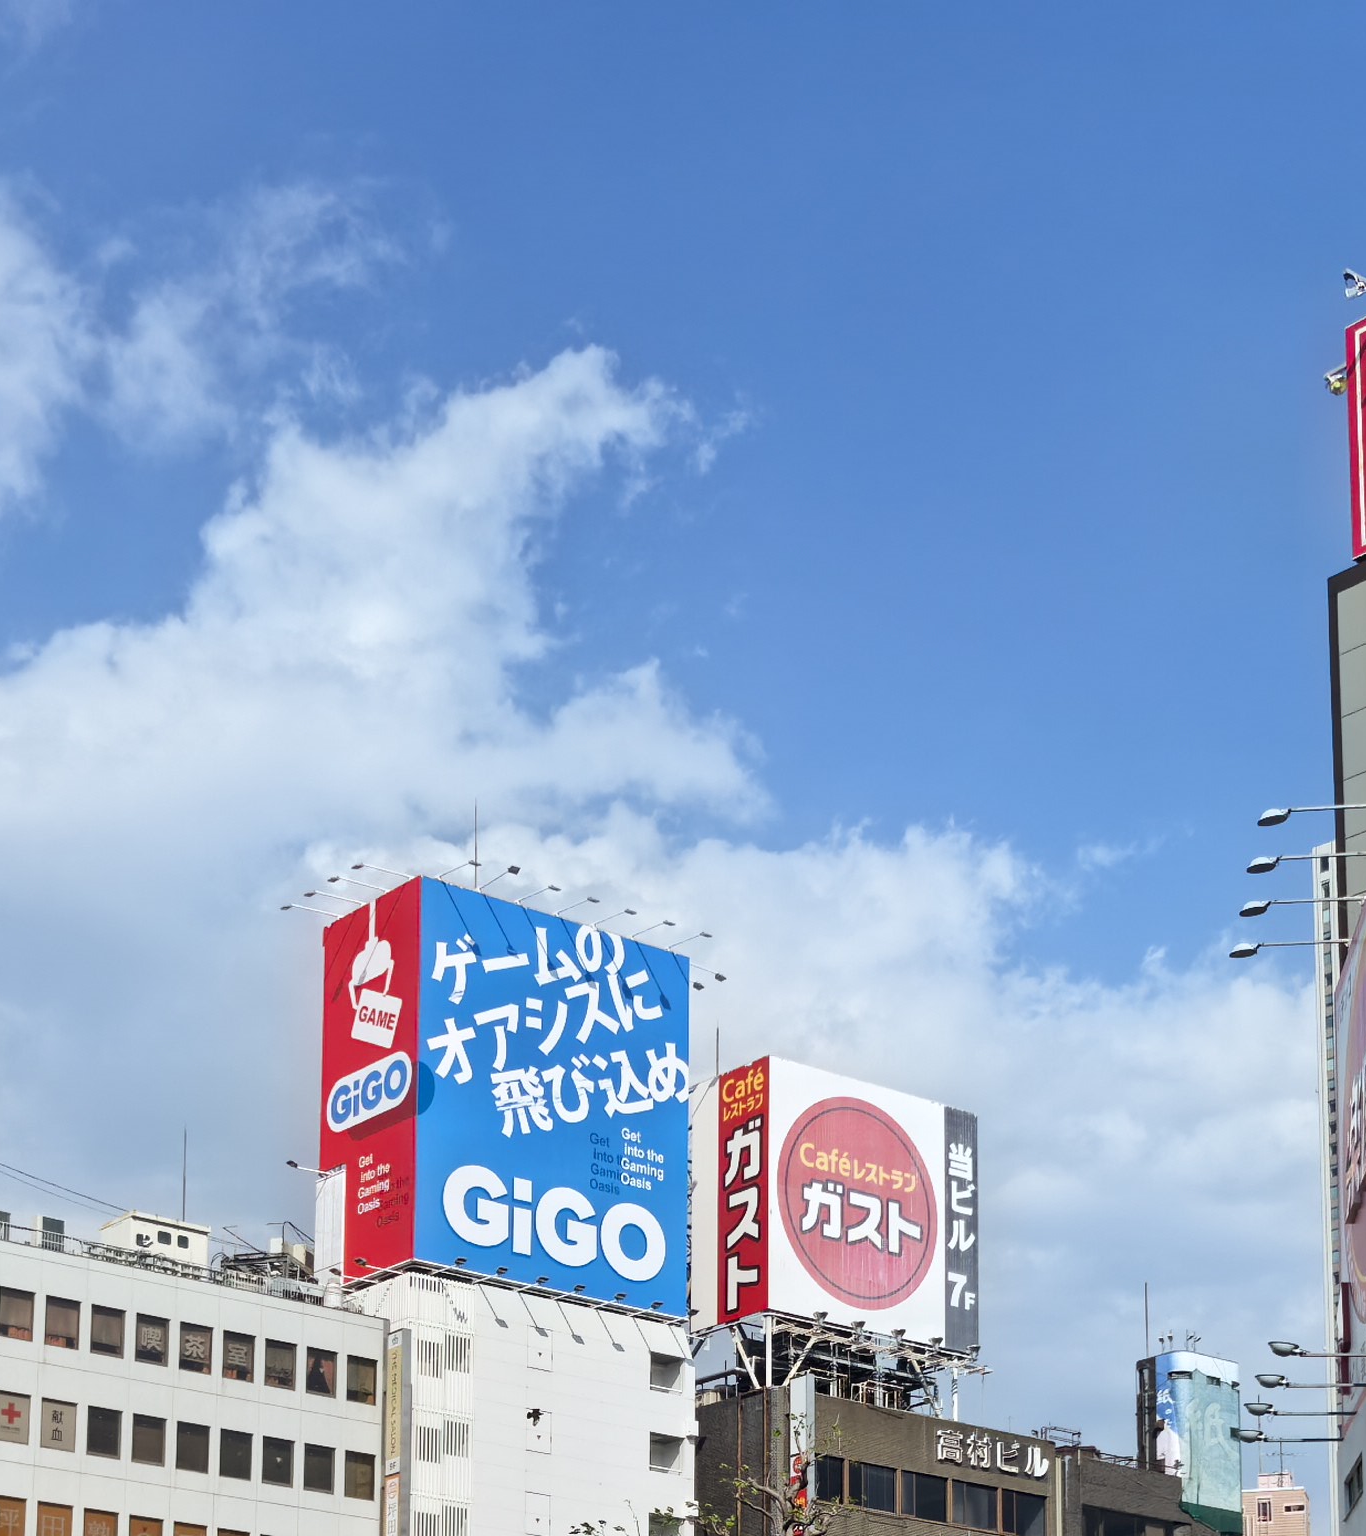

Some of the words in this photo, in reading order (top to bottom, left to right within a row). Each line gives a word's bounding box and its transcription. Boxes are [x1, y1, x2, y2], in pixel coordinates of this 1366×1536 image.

[431, 923, 626, 1004] ゲームの
[357, 1005, 398, 1033] GAME
[425, 970, 664, 1084] オアシスに
[333, 1059, 408, 1125] GiGO
[492, 1041, 690, 1138] 飛び込め
[722, 1067, 764, 1103] Café
[723, 1093, 763, 1121] レストラン
[621, 1127, 642, 1144] Get
[624, 1143, 645, 1159] into
[647, 1149, 664, 1164] the
[358, 1153, 373, 1168] Get
[360, 1169, 375, 1183] into
[377, 1163, 391, 1176] the
[621, 1157, 664, 1182] Gaming
[358, 1179, 390, 1199] Gaming
[621, 1172, 652, 1191] Oasis
[947, 1142, 975, 1253] 当ビル
[357, 1198, 381, 1215] Oasis
[442, 1164, 666, 1283] GiGO
[724, 1115, 763, 1314] ガスト
[801, 1178, 923, 1257] ガスト
[947, 1271, 975, 1311] 7F
[140, 1325, 250, 1368] 喫茶室
[51, 1409, 64, 1442] 献血
[935, 1429, 1049, 1476] 高村ビル
